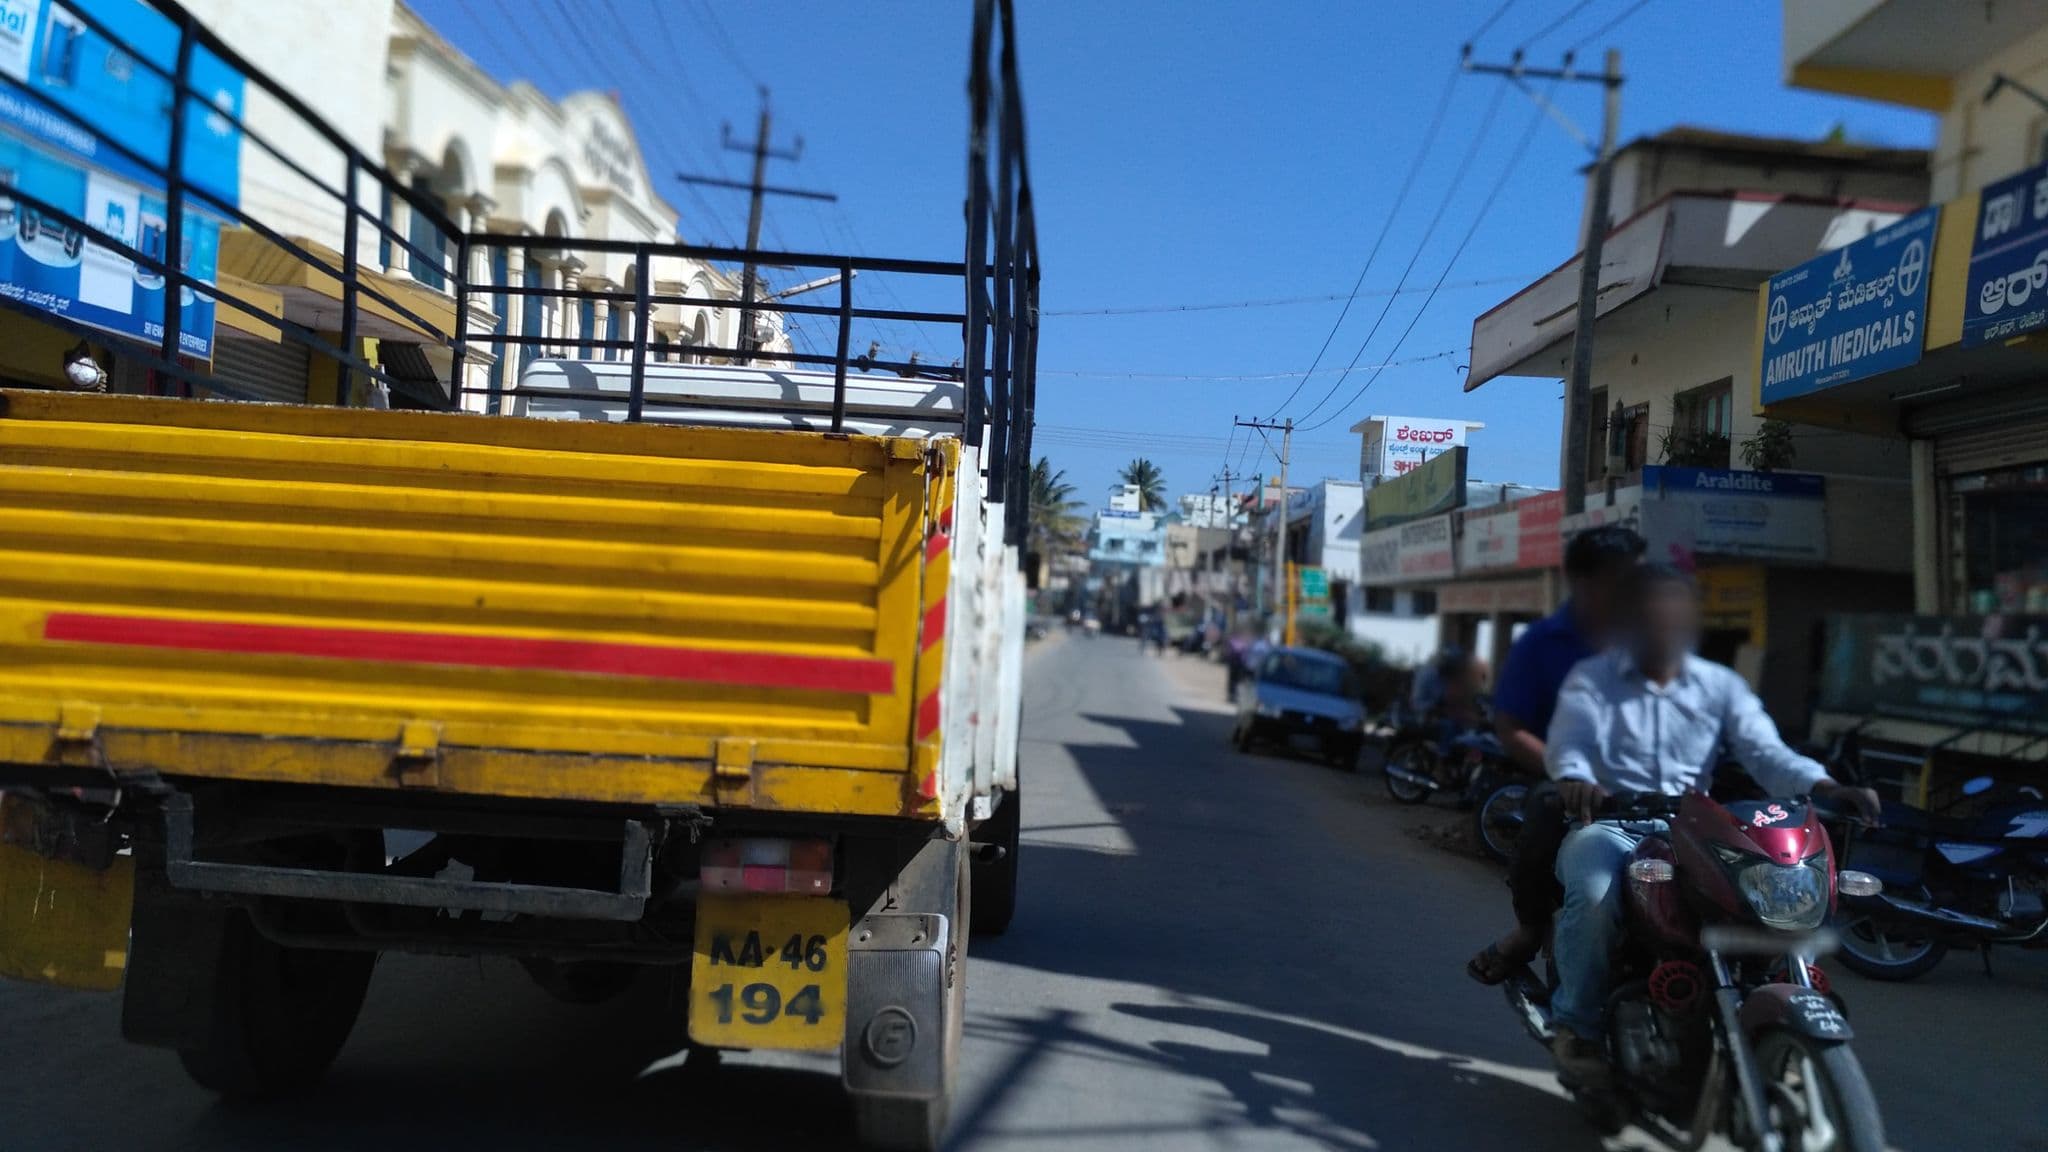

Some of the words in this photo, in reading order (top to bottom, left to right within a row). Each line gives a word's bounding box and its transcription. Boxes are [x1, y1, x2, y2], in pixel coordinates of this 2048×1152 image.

[1765, 339, 1827, 387] AMRUTH
[1829, 309, 1916, 367] MEDICALS
[1396, 425, 1454, 443] ಶೇಖರ್
[1695, 471, 1774, 492] Araldite
[708, 982, 825, 1025] 194
